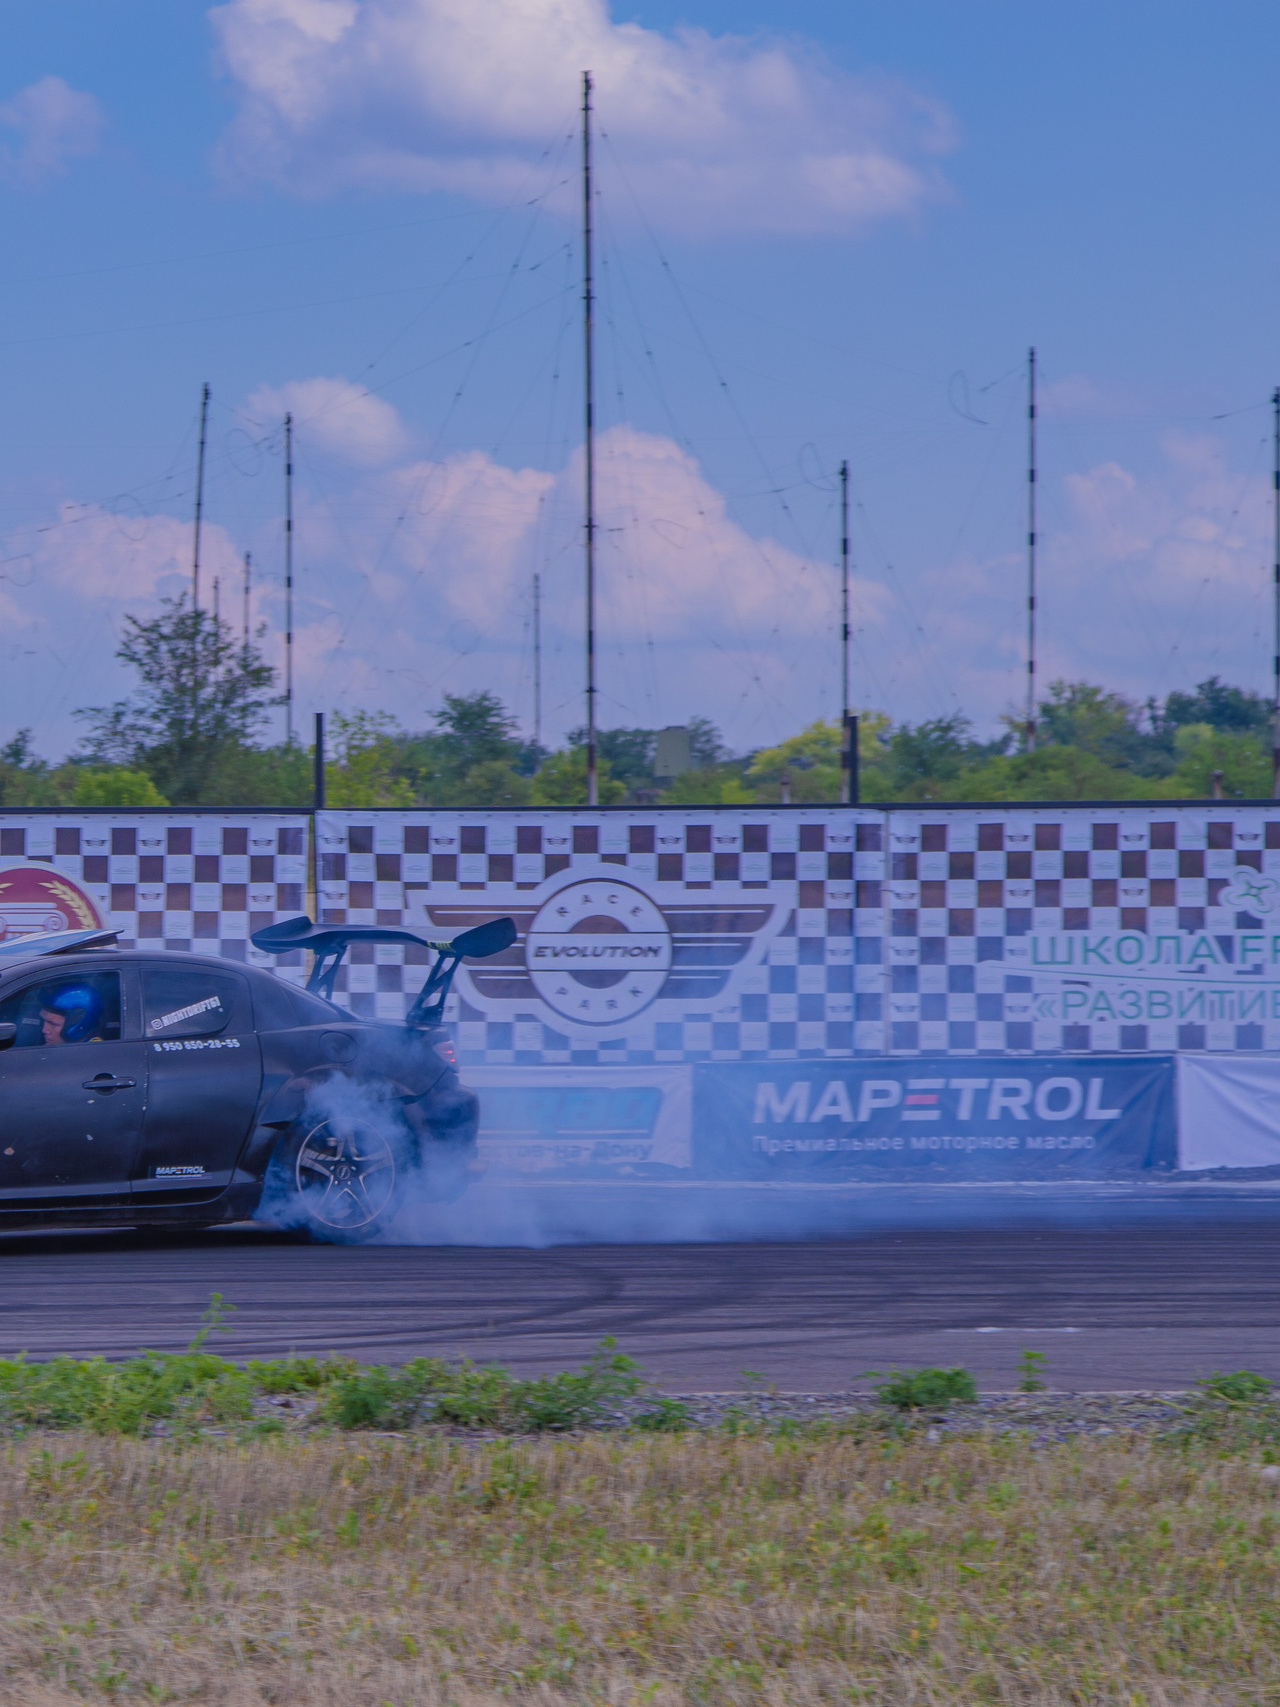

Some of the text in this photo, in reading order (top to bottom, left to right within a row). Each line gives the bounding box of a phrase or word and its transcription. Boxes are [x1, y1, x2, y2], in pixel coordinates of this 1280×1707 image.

[533, 946, 663, 957] EVOLUTION
[1031, 936, 1227, 965] ШКОЛА
[751, 1076, 1123, 1124] MAPETROL
[751, 1134, 1097, 1156] Премиальное моторное масло
[155, 1166, 206, 1174] MAPETROL
